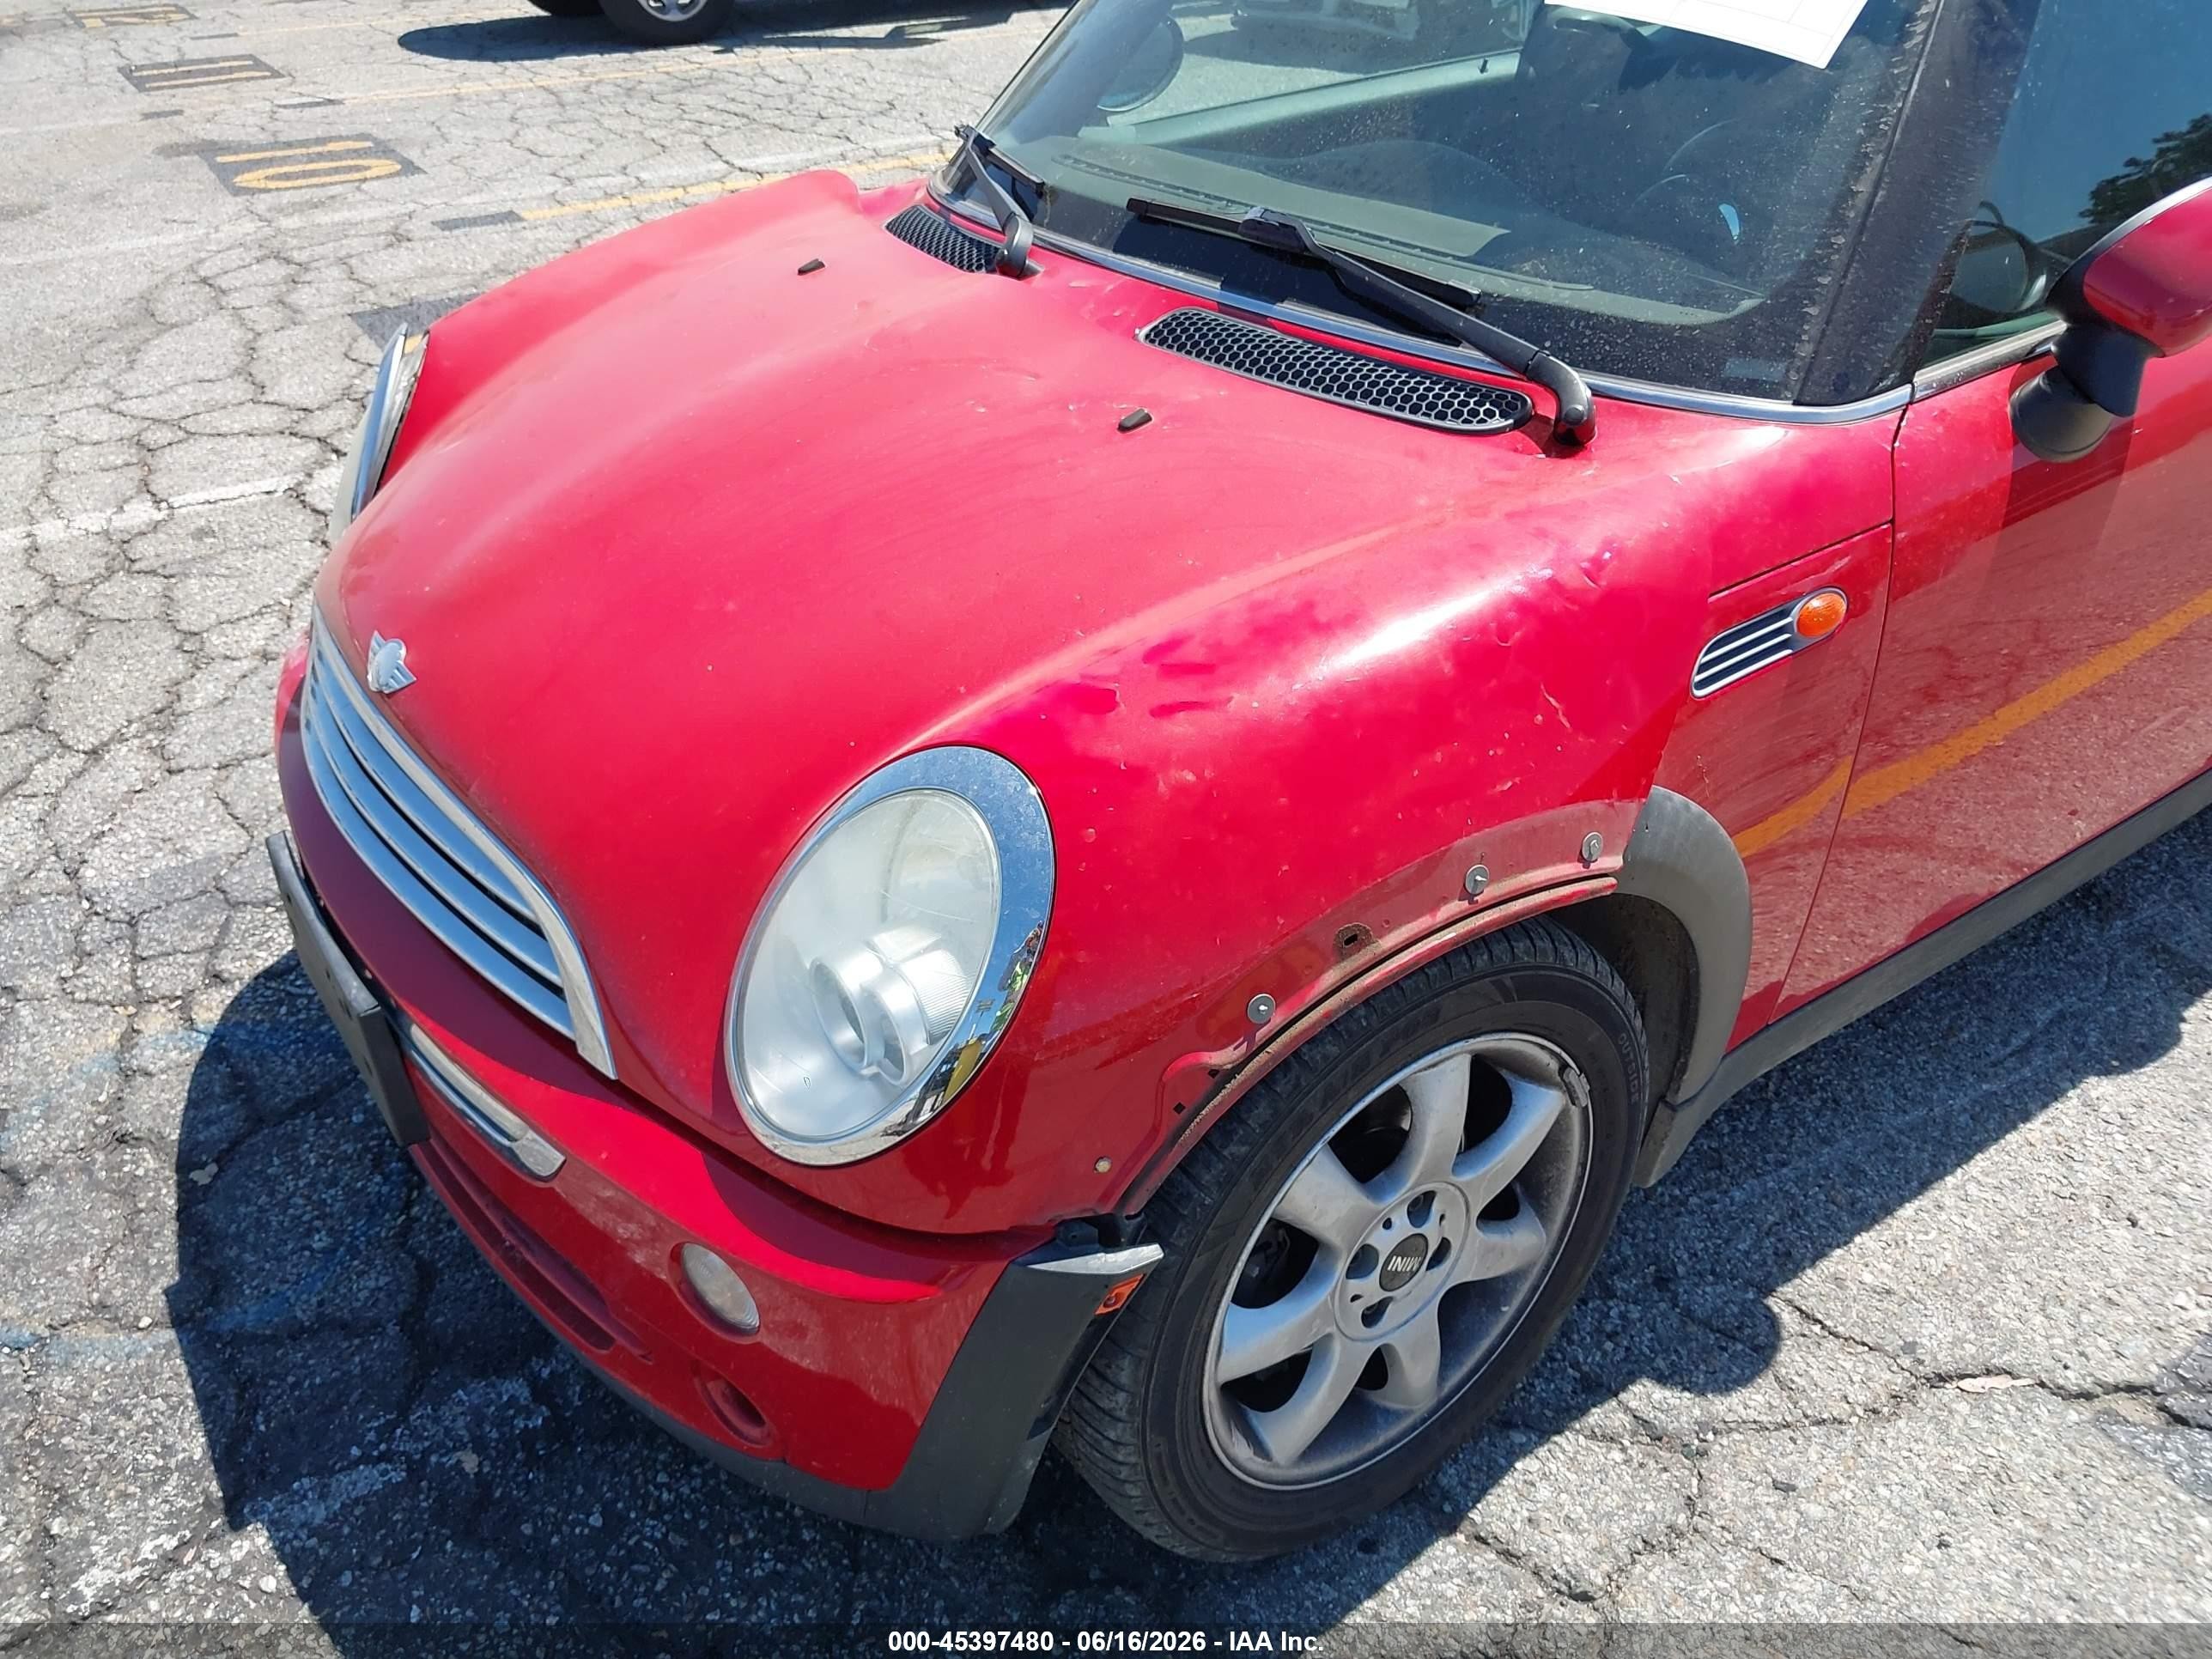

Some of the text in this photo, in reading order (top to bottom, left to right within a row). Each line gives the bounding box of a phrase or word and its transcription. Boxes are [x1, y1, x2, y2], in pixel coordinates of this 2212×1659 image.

[131, 60, 272, 88] 11
[216, 140, 403, 190] 10
[1618, 1033, 1639, 1104] OUTSIDE
[1387, 1255, 1421, 1272] MINI
